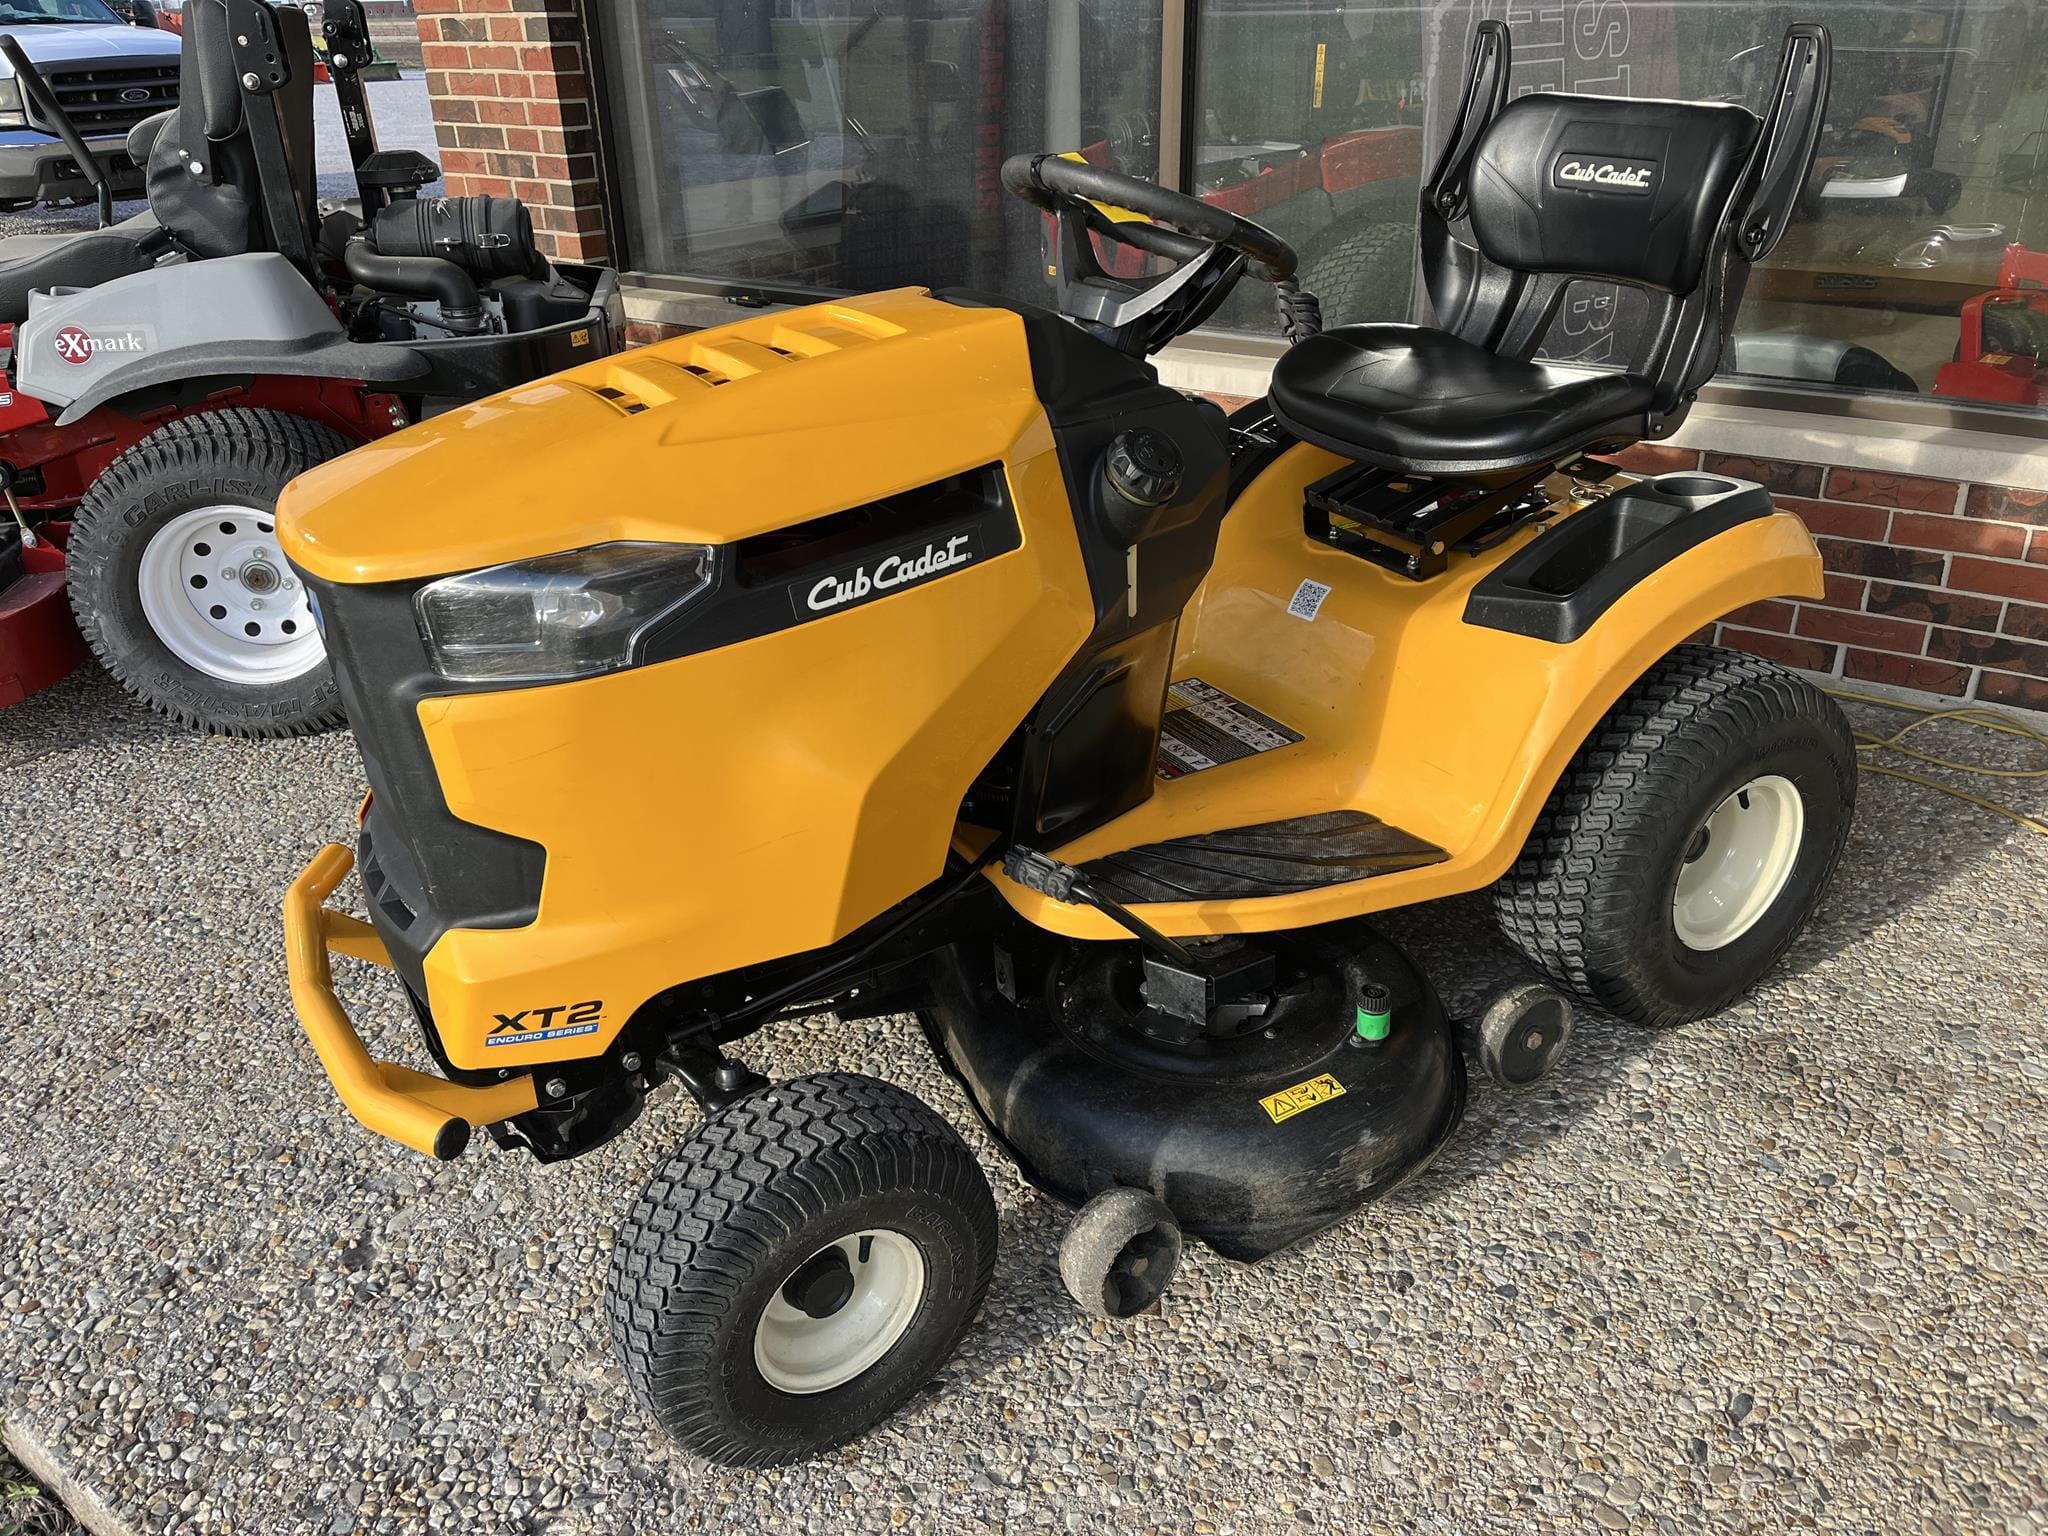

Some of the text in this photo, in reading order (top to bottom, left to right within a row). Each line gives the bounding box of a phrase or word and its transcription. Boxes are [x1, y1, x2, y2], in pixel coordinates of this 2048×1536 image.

[1560, 161, 1652, 187] Cub Cadet
[54, 332, 143, 358] eXmark
[122, 477, 278, 529] CARLISL
[807, 534, 969, 611] Cub Cadet
[487, 1000, 604, 1035] XT2
[487, 1025, 595, 1045] ENDURO SERIES
